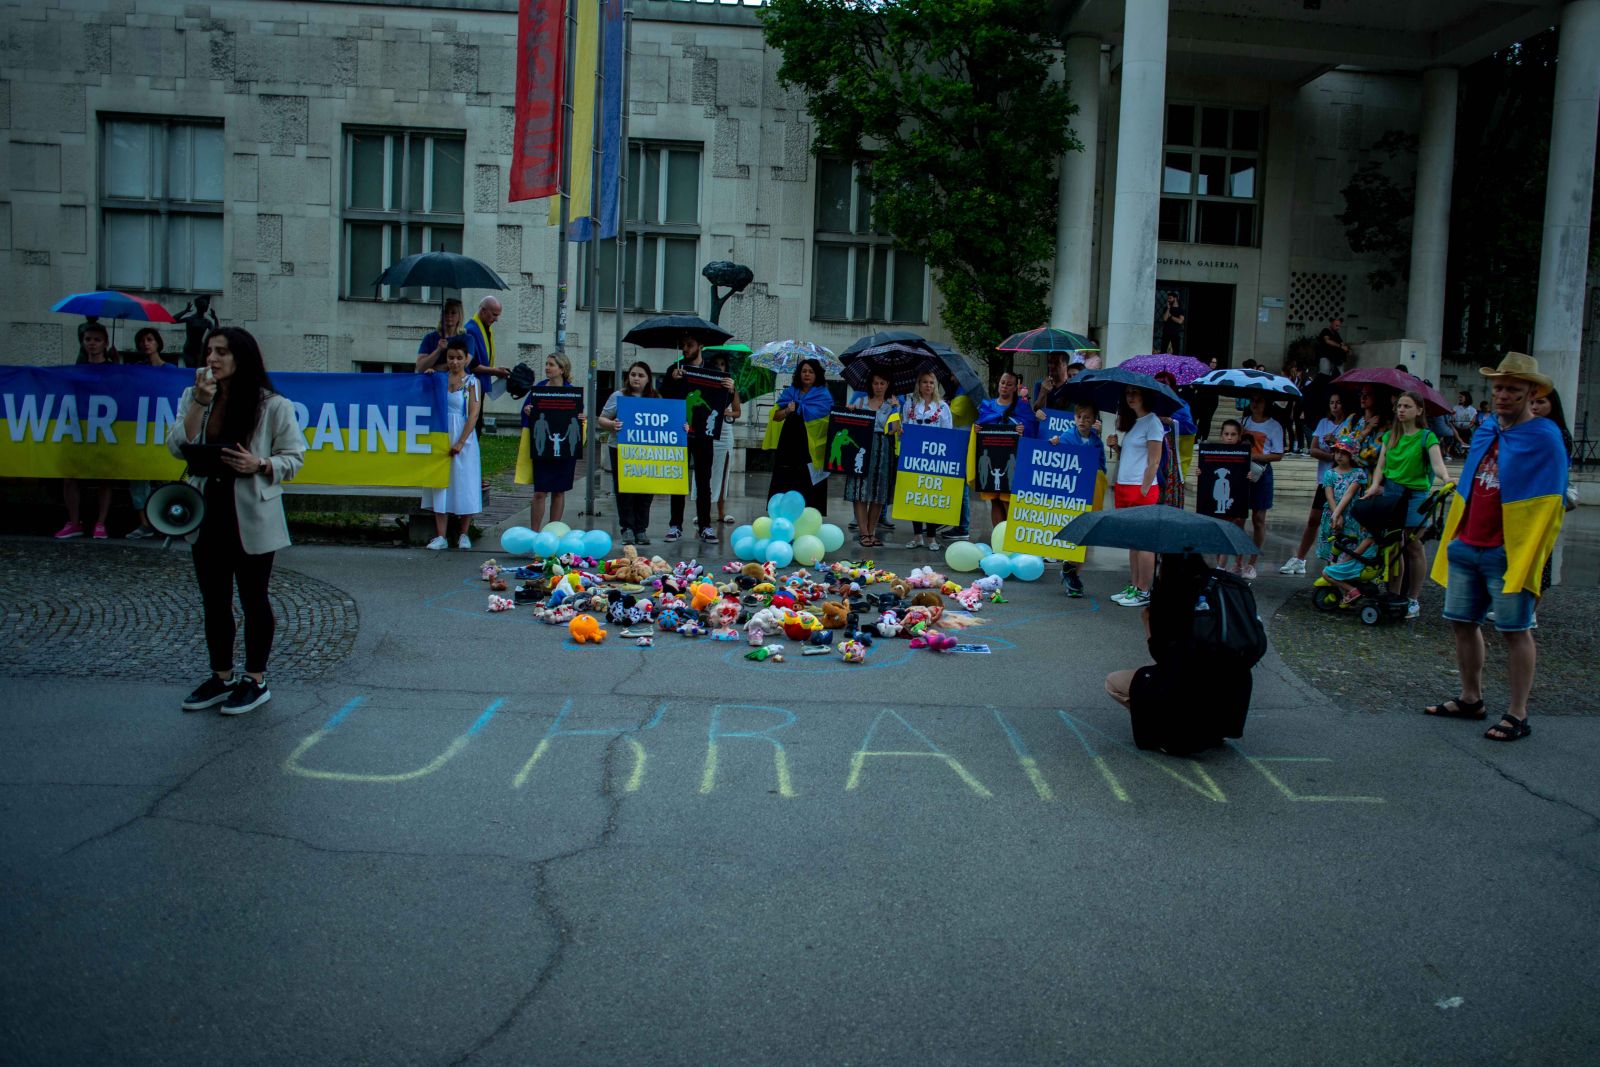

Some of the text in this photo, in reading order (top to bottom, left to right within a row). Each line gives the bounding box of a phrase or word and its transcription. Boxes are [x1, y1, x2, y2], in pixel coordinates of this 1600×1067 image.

[1157, 258, 1239, 270] ODERNA GALERIJA
[3, 393, 432, 454] WAR IN RAINE
[634, 412, 669, 427] STOP
[1048, 416, 1076, 432] RUSS
[626, 428, 678, 445] KILLING
[621, 446, 685, 462] UKRANIAN
[921, 440, 947, 457] FOR
[903, 455, 960, 476] UKRAINE!
[1031, 448, 1082, 474] RUSIJA,
[623, 463, 683, 479] FAMILIES!
[917, 475, 943, 491] FOR
[1031, 470, 1077, 494] NEHAJ
[905, 490, 951, 509] PEACE!
[1016, 489, 1087, 513] POSILJEVATI
[281, 694, 1387, 803] UKRAINE
